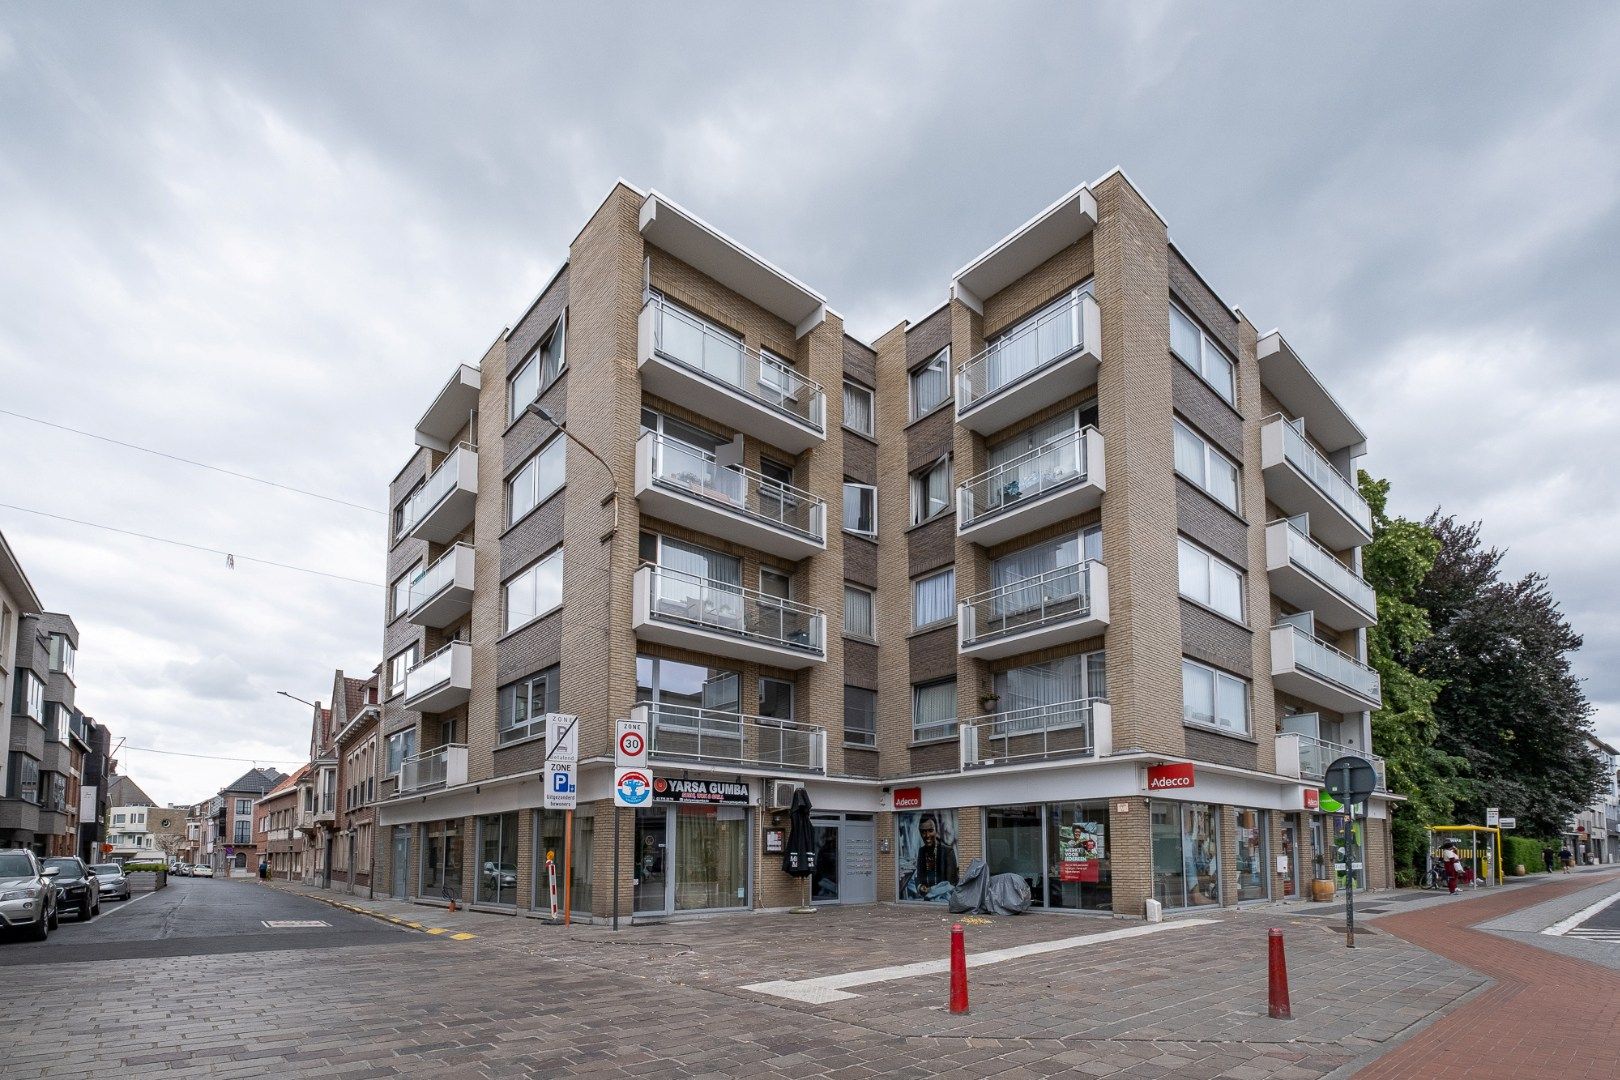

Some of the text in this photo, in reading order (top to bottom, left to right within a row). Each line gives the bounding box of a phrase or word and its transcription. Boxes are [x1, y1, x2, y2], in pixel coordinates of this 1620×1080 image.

[625, 739, 639, 749] 30
[551, 763, 571, 771] ZONE
[1151, 776, 1190, 788] Adecco
[668, 780, 707, 793] YARSA
[709, 782, 748, 796] GUMBA
[895, 797, 919, 806] Adecco
